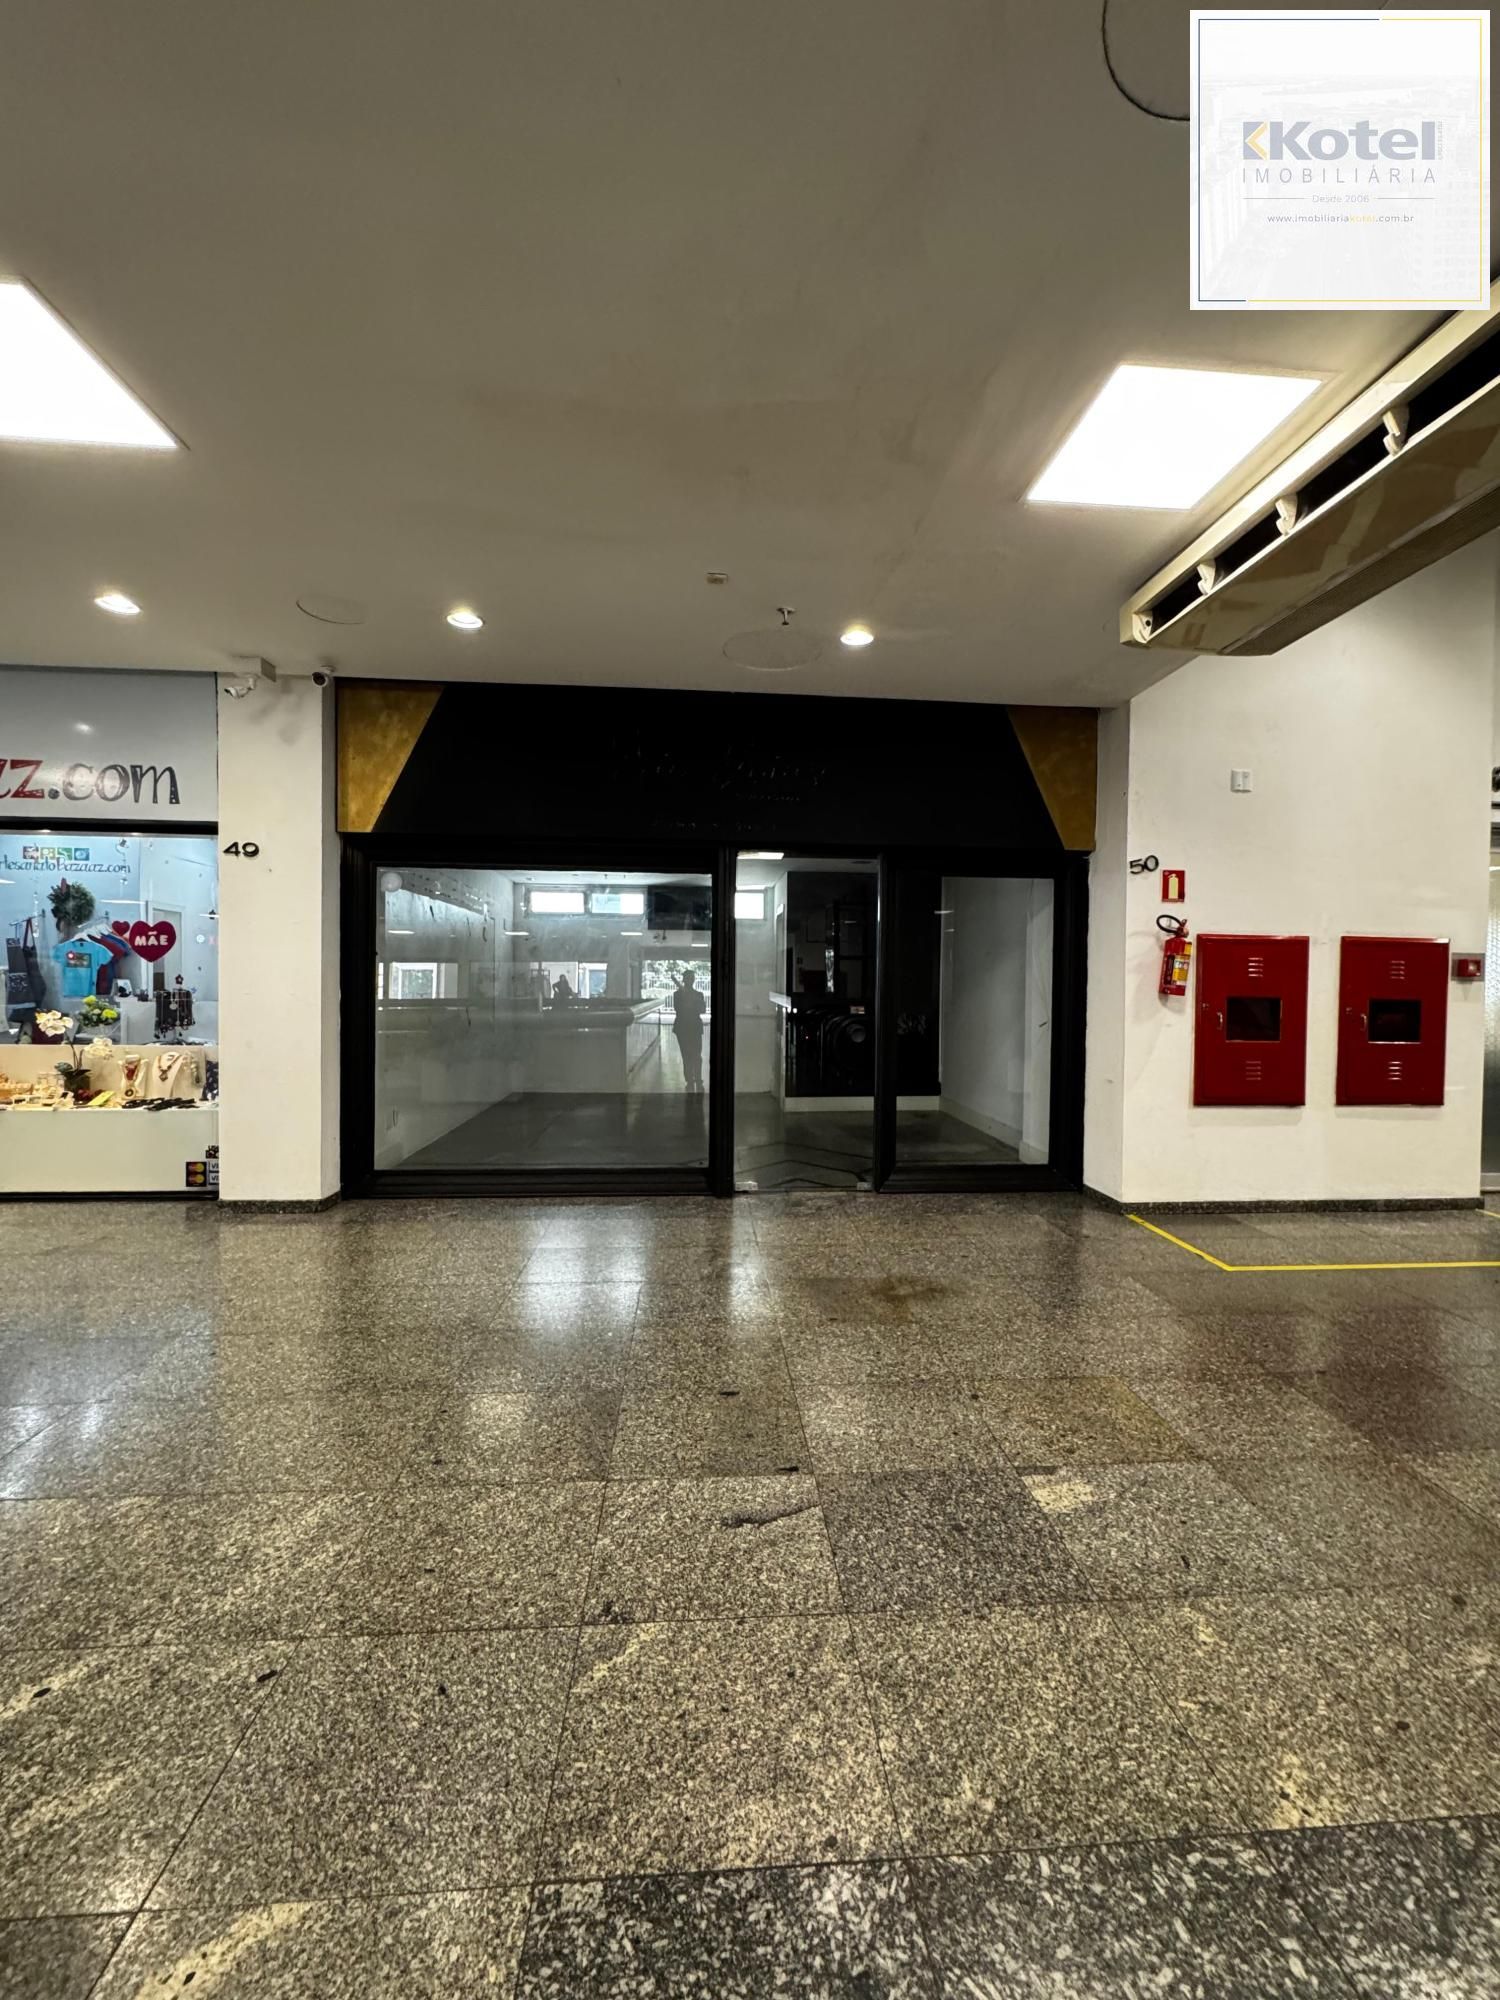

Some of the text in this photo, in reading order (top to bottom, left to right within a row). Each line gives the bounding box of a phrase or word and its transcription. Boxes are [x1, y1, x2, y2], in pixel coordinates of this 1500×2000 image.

[222, 841, 260, 858] 49
[1129, 854, 1159, 875] 50
[134, 931, 169, 946] MÃE
